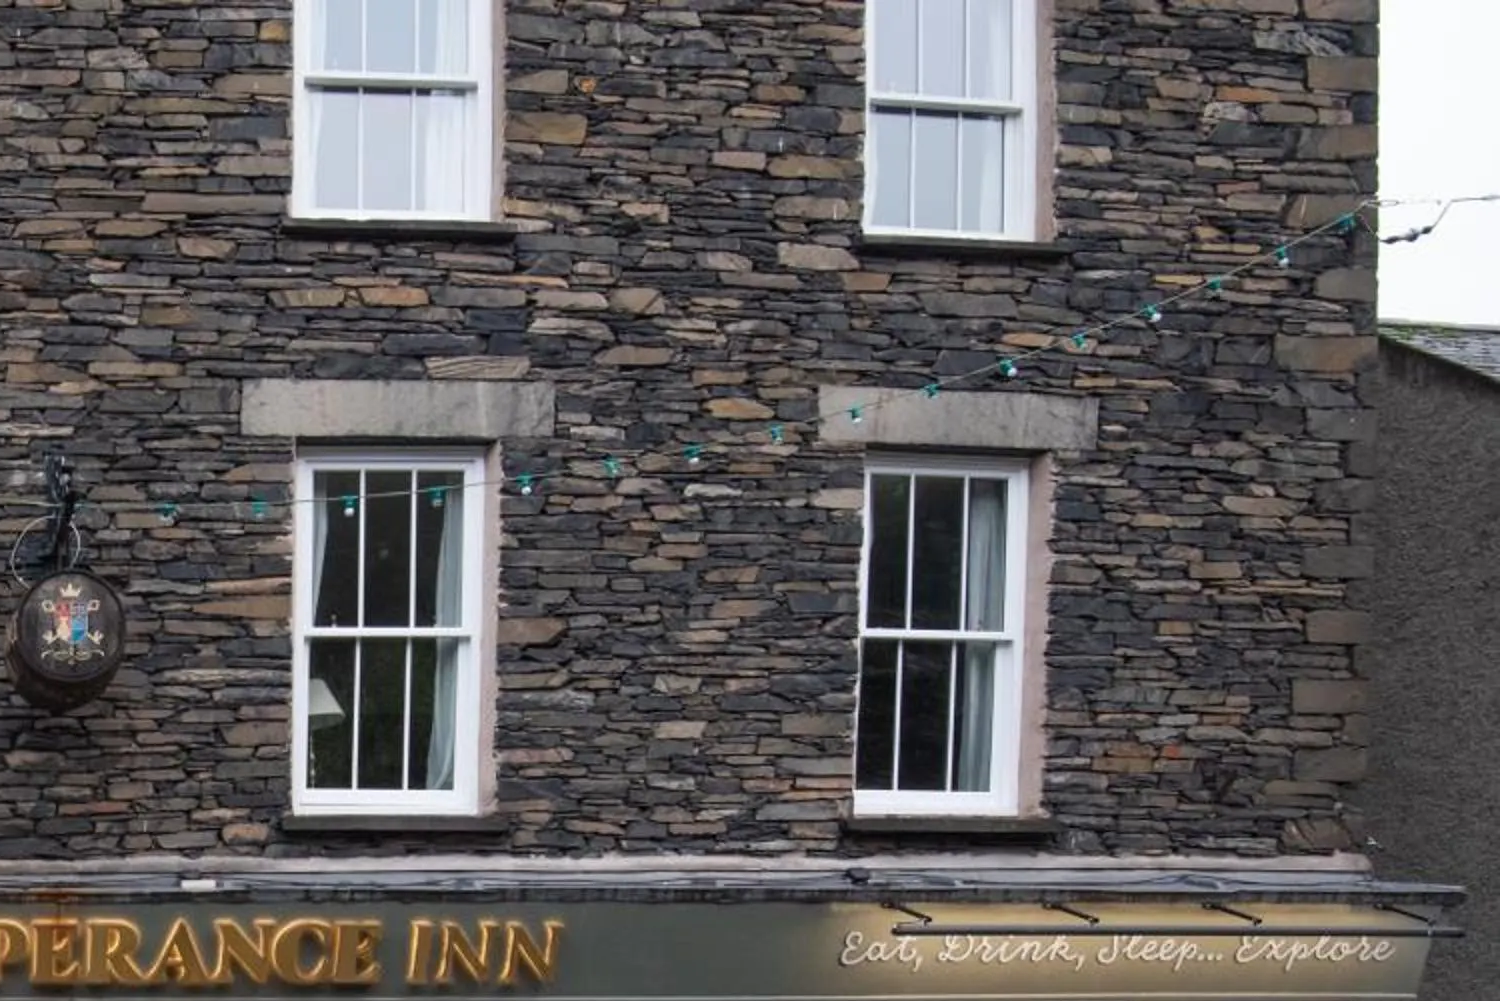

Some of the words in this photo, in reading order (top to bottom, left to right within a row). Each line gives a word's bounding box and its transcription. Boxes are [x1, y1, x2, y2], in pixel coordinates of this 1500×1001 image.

[406, 918, 565, 985] INN
[839, 931, 924, 971] Eat,
[937, 934, 1085, 971] Drink,
[1097, 934, 1224, 972] Sleep...
[1234, 934, 1397, 972] Explore
